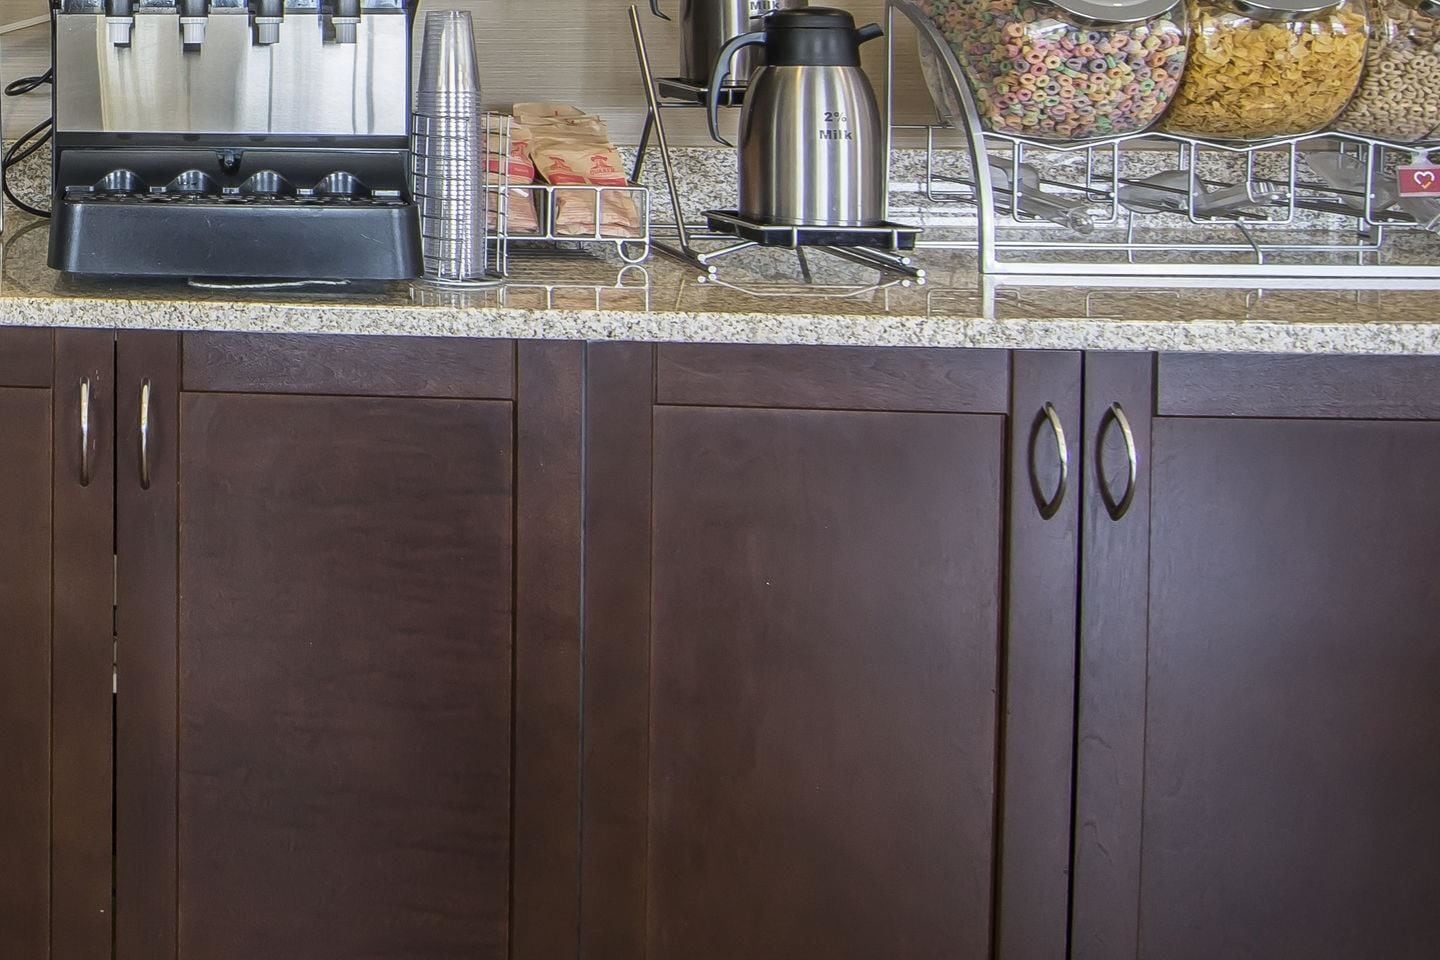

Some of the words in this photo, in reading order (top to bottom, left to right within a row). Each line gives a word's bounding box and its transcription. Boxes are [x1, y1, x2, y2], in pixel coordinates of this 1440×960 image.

[750, 1, 781, 10] Milk
[824, 111, 848, 122] 2%
[819, 129, 853, 140] Milk
